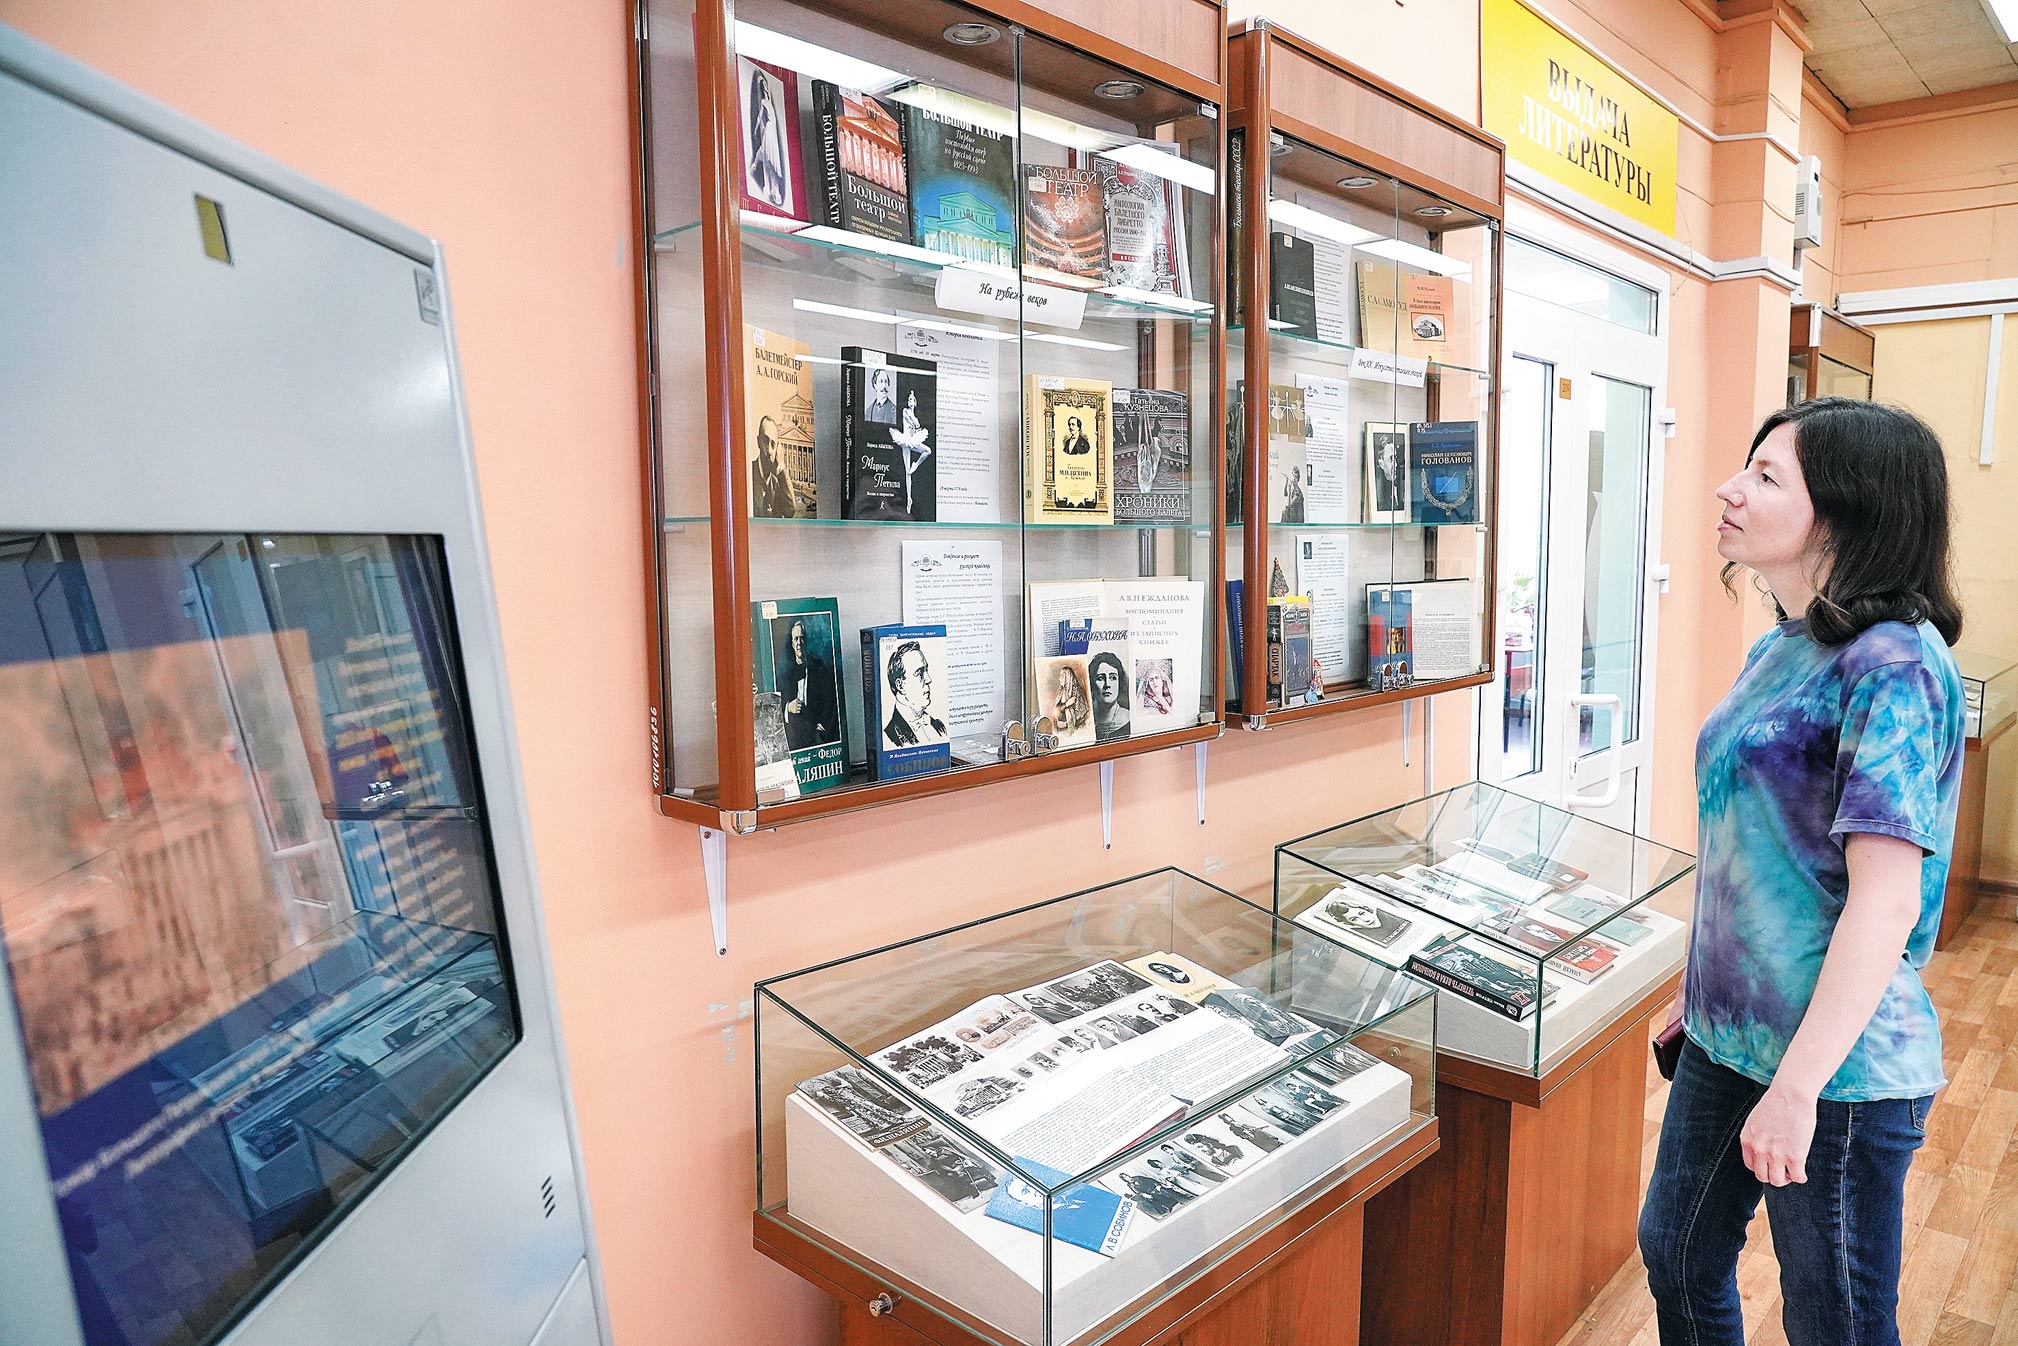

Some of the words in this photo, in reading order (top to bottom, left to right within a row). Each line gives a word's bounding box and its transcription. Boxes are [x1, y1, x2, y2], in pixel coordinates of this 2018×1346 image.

[1548, 58, 1631, 148] ВЫДАЧА
[823, 114, 839, 181] БОЛЬШОЙ
[1232, 137, 1242, 163] СССР
[1518, 94, 1652, 206] ЛИТЕРАТУРЫ
[1036, 166, 1098, 185] БОЛЬШОЙ
[1233, 163, 1244, 192] театр
[846, 174, 906, 214] Большой
[1045, 179, 1090, 198] ТЕАТР
[828, 183, 840, 224] ТЕАТР
[854, 198, 886, 223] театр
[1114, 208, 1145, 220] БАЛЕТНОГО
[1233, 193, 1243, 228] Большой
[1116, 218, 1144, 228] ЛИБРЕТТО
[979, 282, 993, 295] На
[995, 286, 1024, 302] рубеж
[1027, 294, 1048, 307] веков
[755, 347, 803, 371] БАЛЕТМЕЙСТЕР
[1123, 403, 1169, 412] КУЗНЕЦОВА
[861, 455, 890, 472] Мариус
[1421, 456, 1473, 465] ГОЛОВАНОВ
[873, 472, 901, 488] Петипа
[1115, 496, 1181, 508] ХРОНИКИ
[1116, 508, 1156, 516] БОЛЬШОГО
[1157, 508, 1184, 516] БАЛЕТА
[1271, 647, 1280, 678] СПАРТАК
[796, 760, 844, 785] АЛЯПИН
[886, 754, 948, 775] СОБИНОВ
[1111, 1200, 1133, 1237] СОБИНОВ
